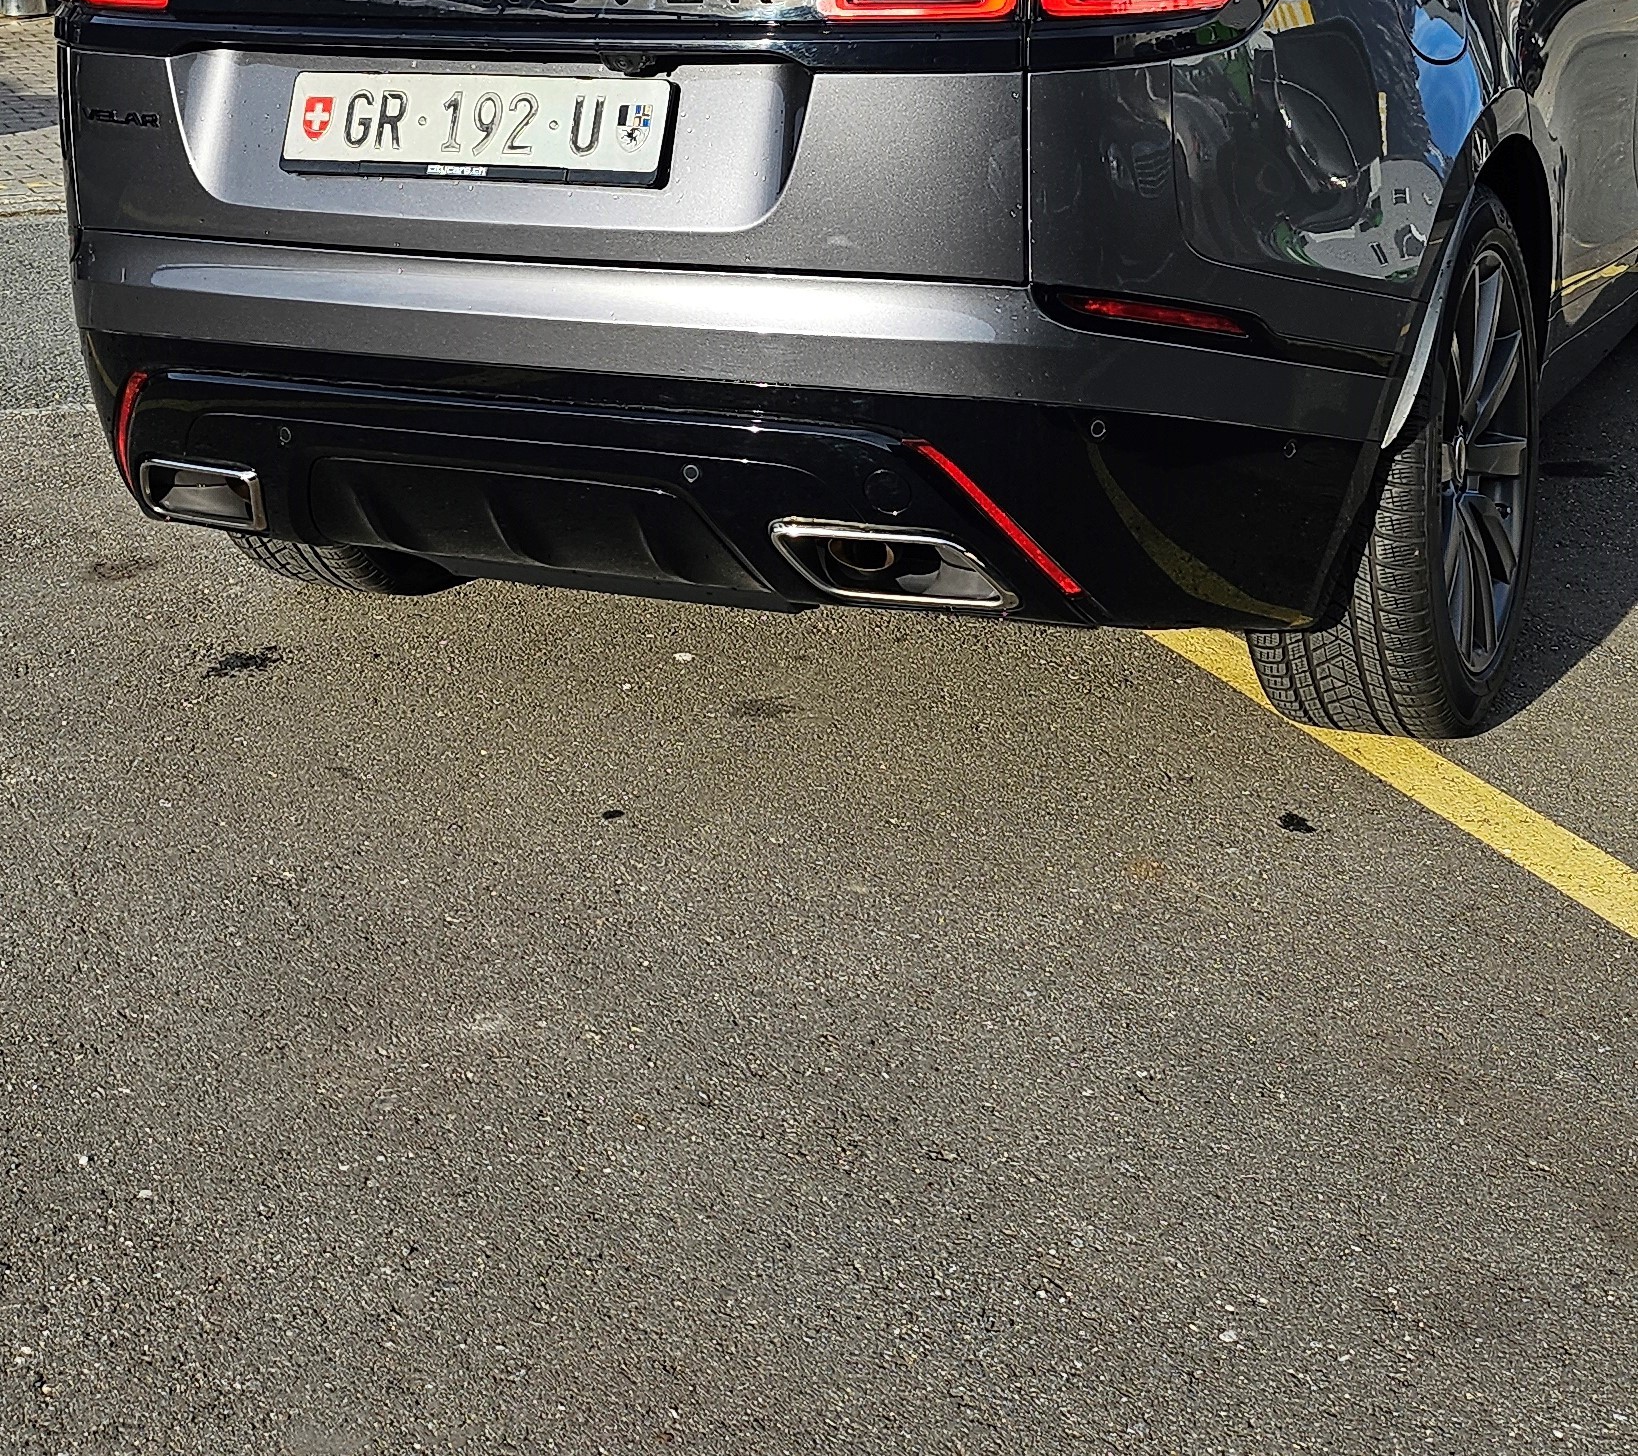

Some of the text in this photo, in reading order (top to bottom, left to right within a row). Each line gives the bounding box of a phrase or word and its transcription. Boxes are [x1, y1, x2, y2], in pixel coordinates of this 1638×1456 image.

[82, 107, 161, 128] VELAR
[343, 89, 606, 158] GR 192 U
